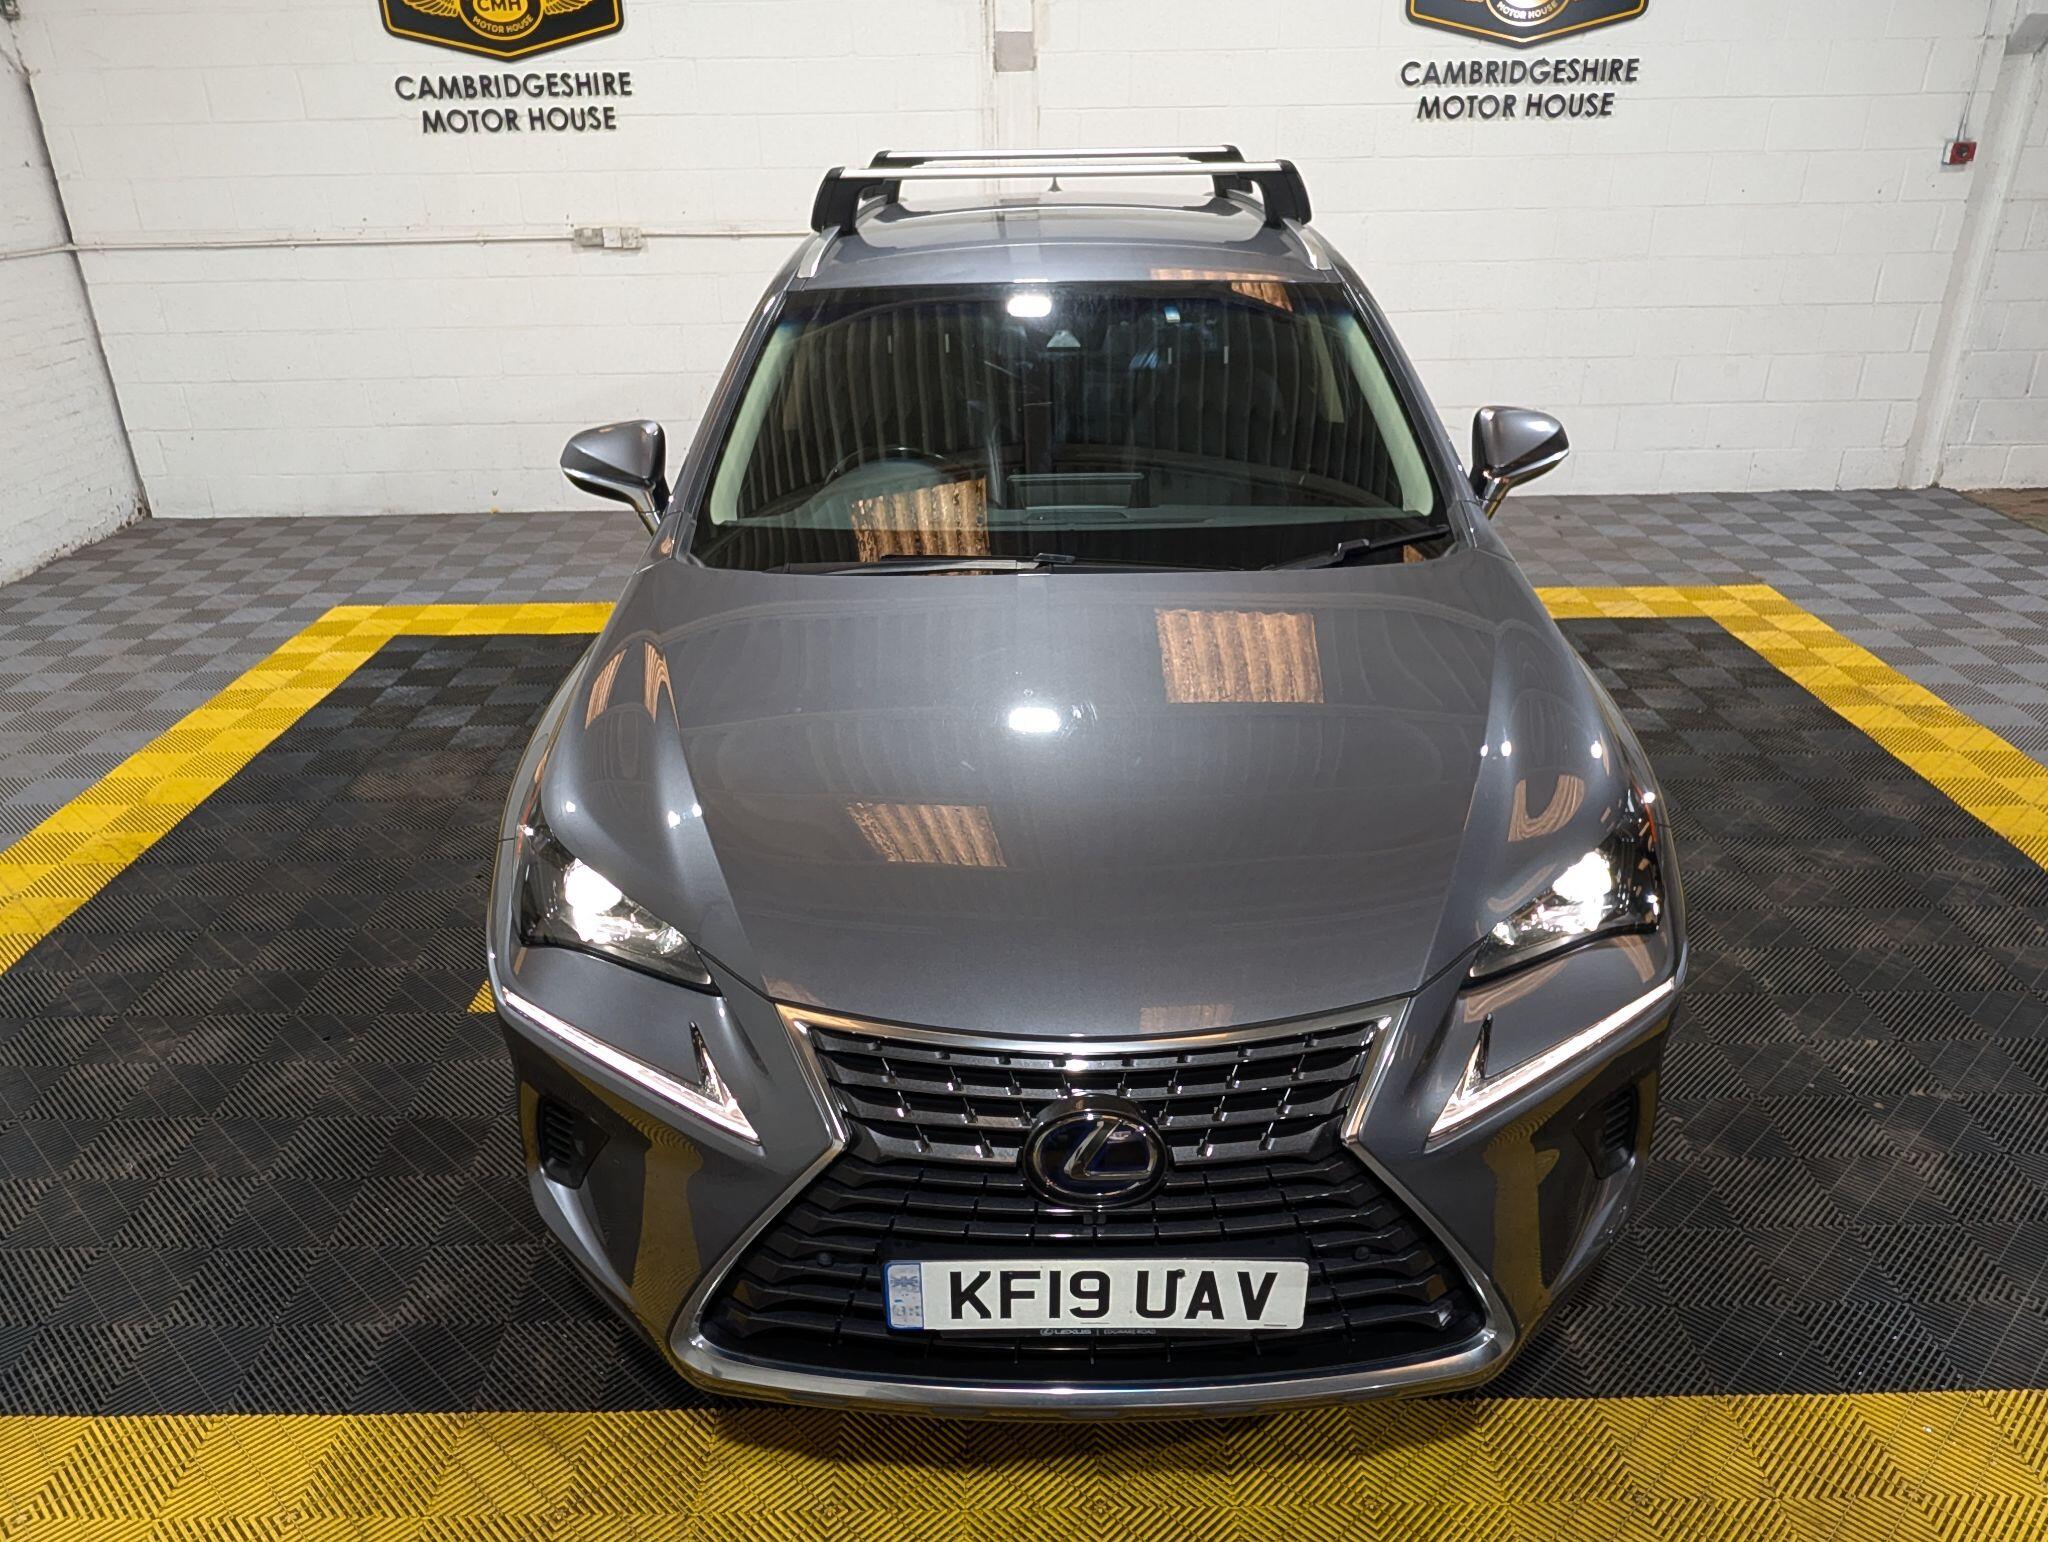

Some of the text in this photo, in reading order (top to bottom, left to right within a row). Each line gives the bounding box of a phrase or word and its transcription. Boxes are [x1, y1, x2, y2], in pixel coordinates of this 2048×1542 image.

[477, 0, 522, 12] CMH
[1496, 0, 1558, 20] MOTOR HOUSE
[472, 14, 534, 34] MOTOR HOUSE
[394, 72, 633, 101] CAMBRIDGESHIRE
[1400, 58, 1640, 88] CAMBRIDGESHIRE
[1416, 92, 1616, 120] MOTOR HOUSE
[422, 107, 617, 134] MOTOR HOUSE
[949, 1269, 1279, 1321] KF19 UAV
